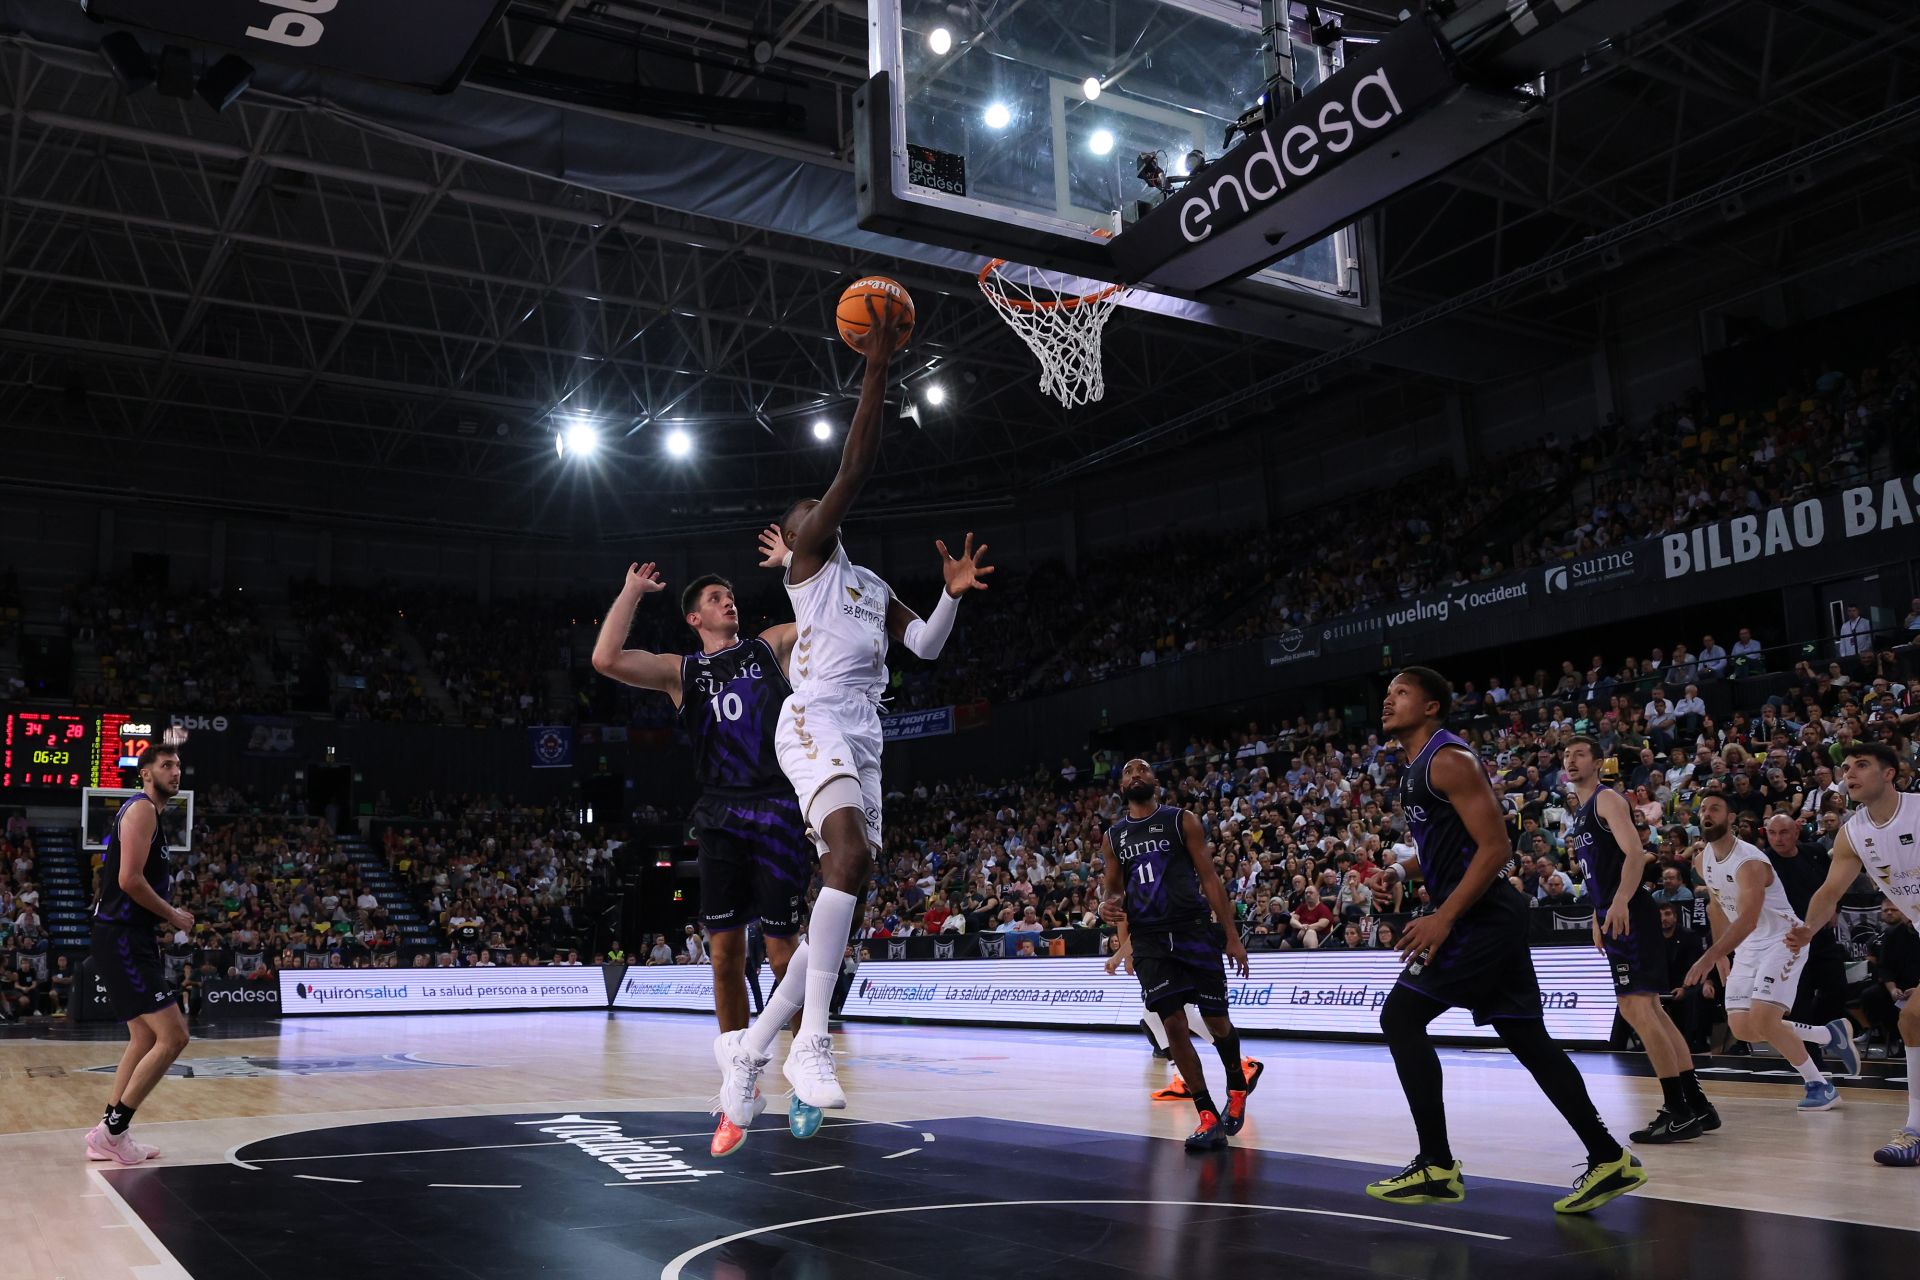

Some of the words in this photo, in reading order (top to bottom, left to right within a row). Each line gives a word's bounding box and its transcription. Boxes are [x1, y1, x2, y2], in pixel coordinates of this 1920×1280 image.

[1179, 66, 1403, 243] endesa
[850, 279, 902, 297] Wilson
[1662, 497, 1825, 580] BILBAO
[1572, 550, 1634, 579] surne
[1469, 582, 1528, 607] Occident
[1386, 600, 1449, 627] vueling
[710, 692, 743, 722] 10
[25, 722, 43, 736] 34
[66, 724, 84, 738] 28
[33, 750, 70, 764] 06:23
[1120, 839, 1170, 864] surne
[1137, 861, 1155, 884] 11
[207, 986, 277, 1004] endesa
[422, 986, 436, 997] La
[440, 985, 473, 997] salud
[477, 986, 527, 998] persona
[530, 987, 538, 995] a
[541, 985, 589, 996] persona
[945, 985, 958, 1000] La
[959, 985, 991, 1000] salud
[991, 989, 1038, 1004] persona
[1042, 991, 1050, 1001] a
[1051, 989, 1104, 1006] persona
[1290, 986, 1310, 1005] La
[1314, 985, 1368, 1006] salud
[539, 1124, 725, 1180] Occident
